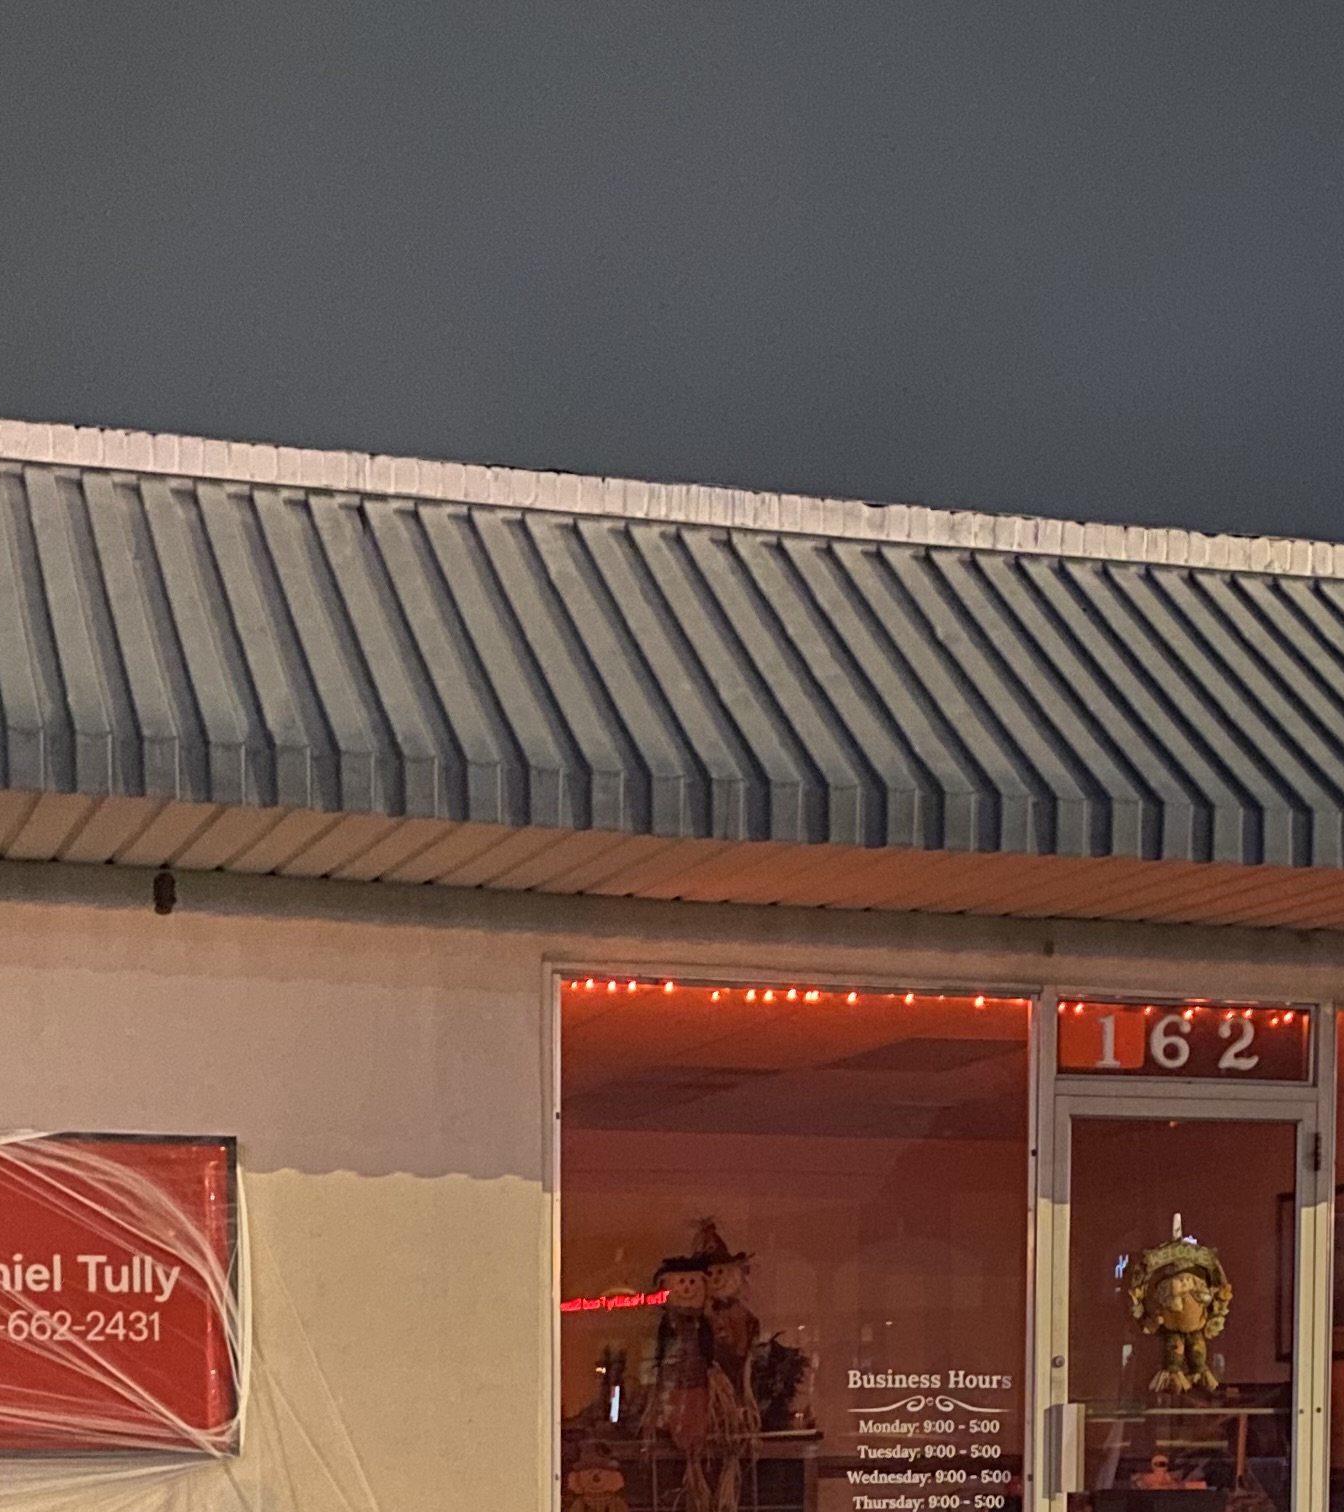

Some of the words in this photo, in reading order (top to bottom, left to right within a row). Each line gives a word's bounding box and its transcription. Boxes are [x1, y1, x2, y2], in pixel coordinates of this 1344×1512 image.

[1149, 1244, 1212, 1267] WELCOME
[77, 1255, 181, 1302] Tully
[848, 1369, 941, 1389] Business
[948, 1370, 1012, 1389] Hours
[859, 1420, 919, 1437] Monday:
[924, 1420, 954, 1433] 9:00
[969, 1420, 1000, 1433] 5:00
[857, 1445, 921, 1462] Tuesday:
[925, 1445, 955, 1458] 9:00
[971, 1445, 1001, 1458] 5:00
[847, 1470, 931, 1487] Wednesday:
[935, 1470, 966, 1483] 9:00
[981, 1470, 1011, 1483] 5:00
[853, 1495, 924, 1512] Thursday:
[929, 1495, 959, 1508] 9:00
[974, 1495, 1005, 1508] 5:00
